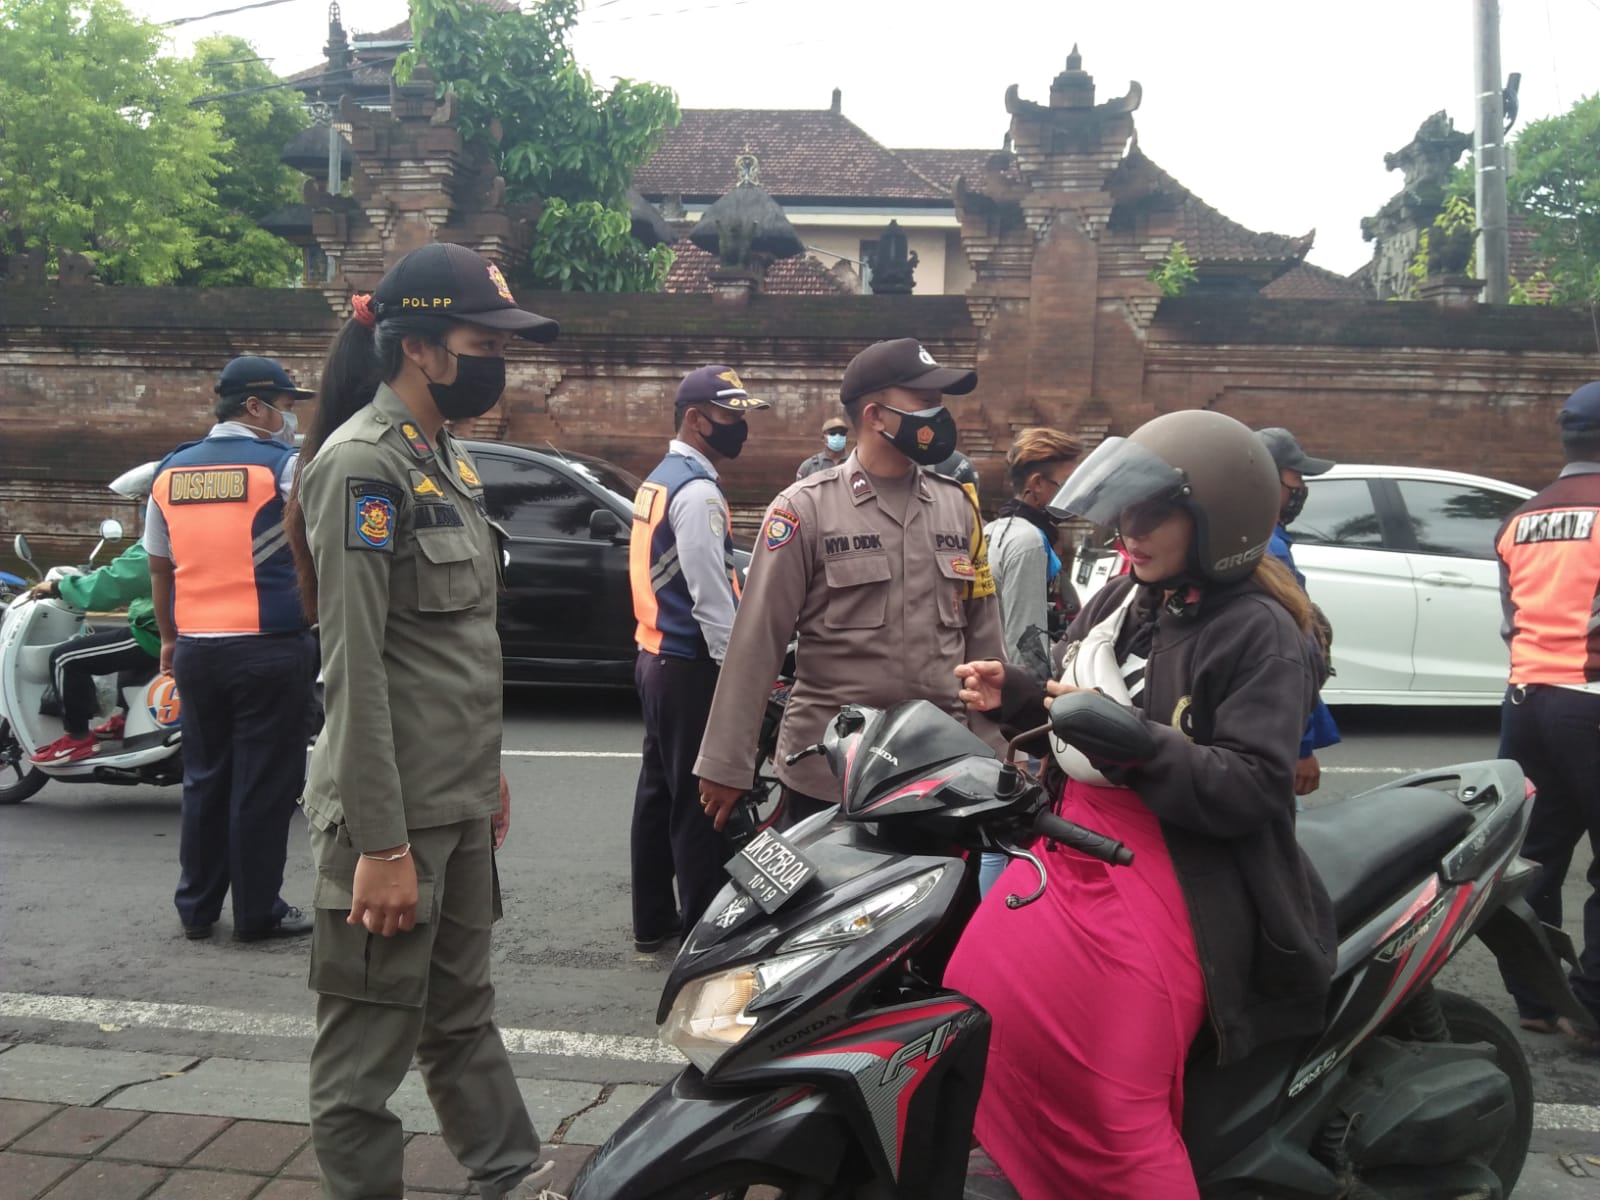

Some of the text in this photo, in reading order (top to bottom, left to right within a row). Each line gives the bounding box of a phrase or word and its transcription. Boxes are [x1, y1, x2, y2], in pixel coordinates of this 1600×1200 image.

[402, 297, 452, 308] POL PP
[171, 471, 245, 501] DISHUB
[743, 831, 774, 859] DK
[758, 841, 796, 876] 6758
[767, 1013, 840, 1053] HONDA
[879, 1021, 952, 1087] FI
